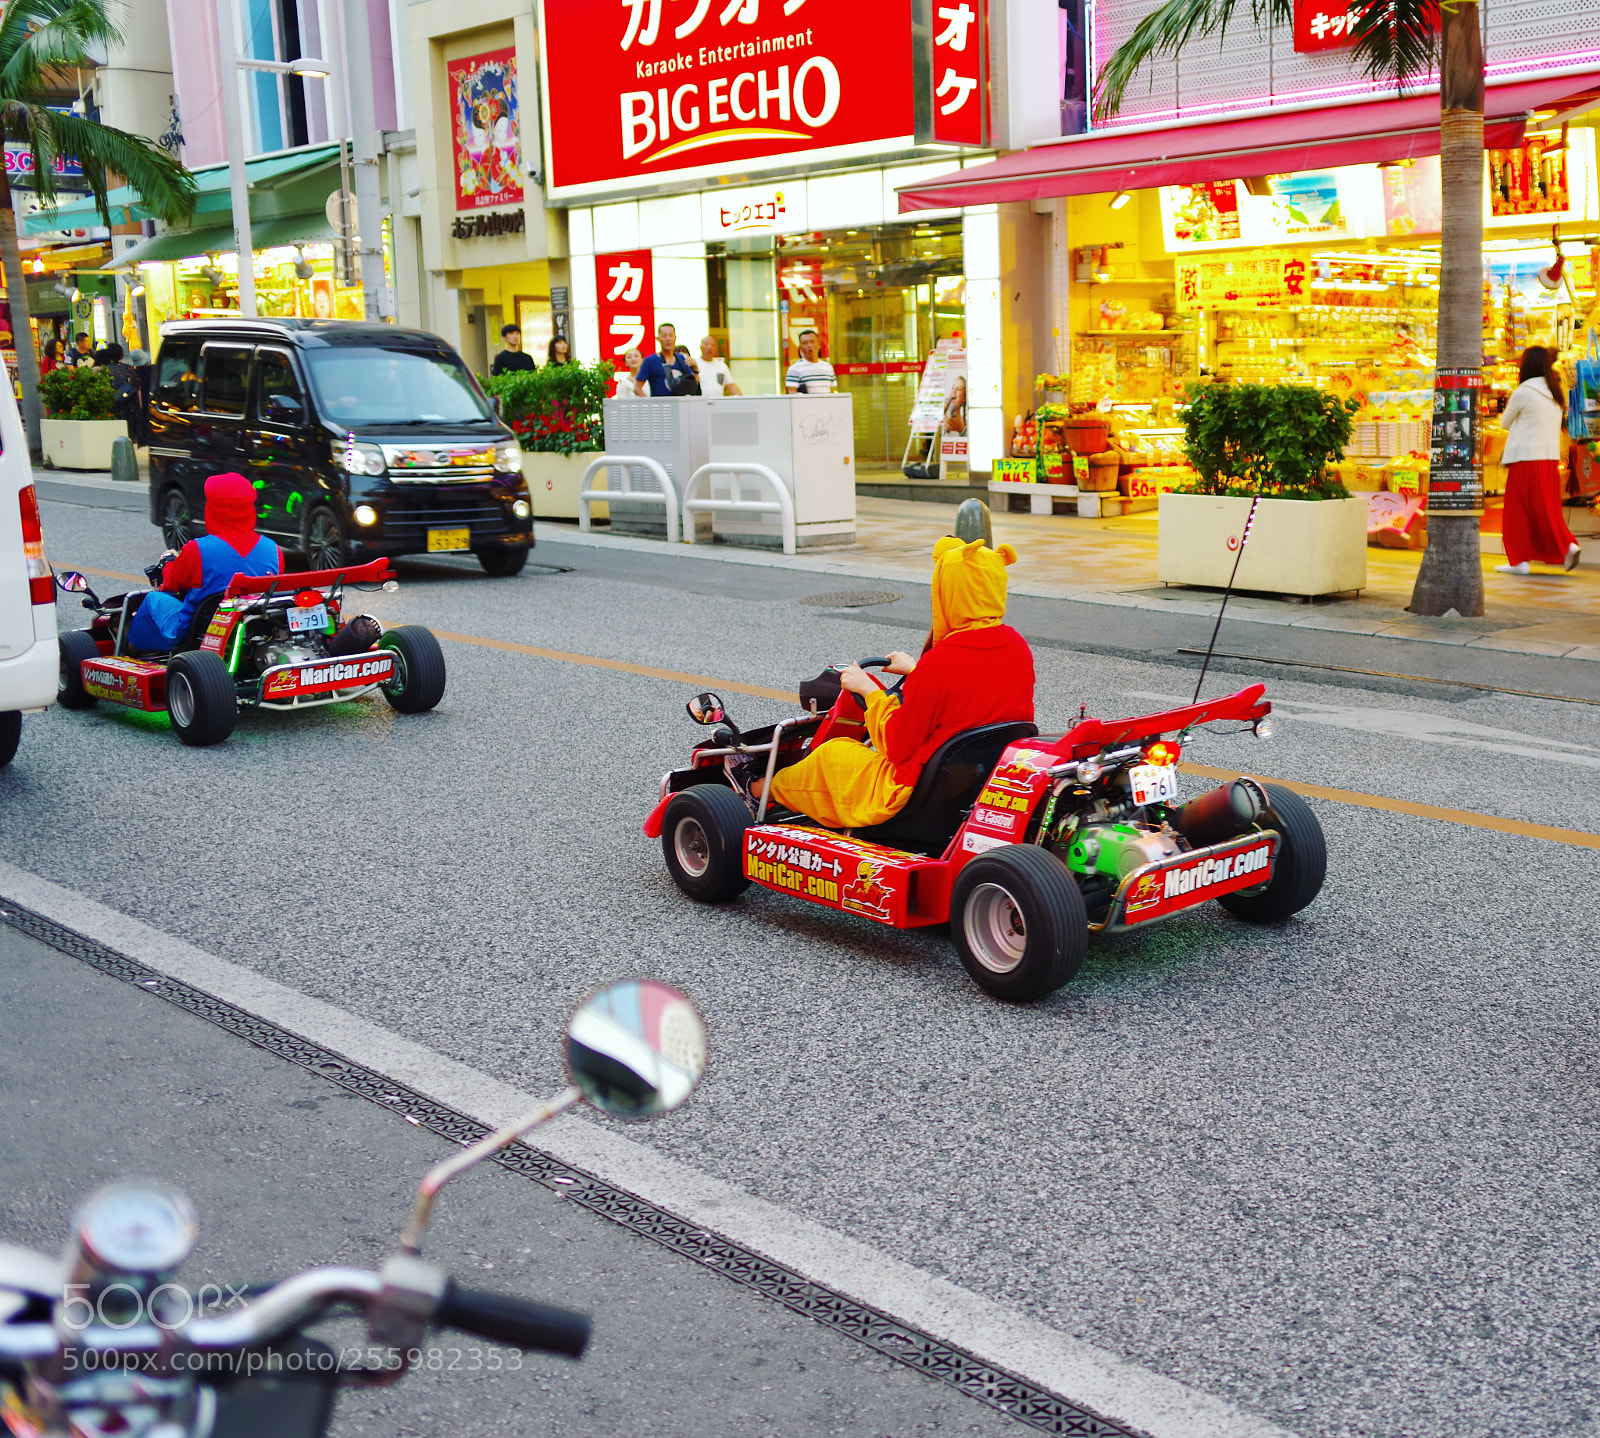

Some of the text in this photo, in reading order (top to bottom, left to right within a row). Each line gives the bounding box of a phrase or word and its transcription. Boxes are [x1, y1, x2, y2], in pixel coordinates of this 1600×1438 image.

[636, 28, 814, 79] Karaoke Entertainment
[935, 3, 977, 116] オケ
[620, 55, 842, 160] BIG ECHO
[1284, 259, 1305, 295] 安
[300, 657, 392, 687] MariCar.com
[747, 853, 839, 902] MariCar.com
[748, 834, 843, 878] レンタル公道カート
[1164, 845, 1270, 899] MariCar.com
